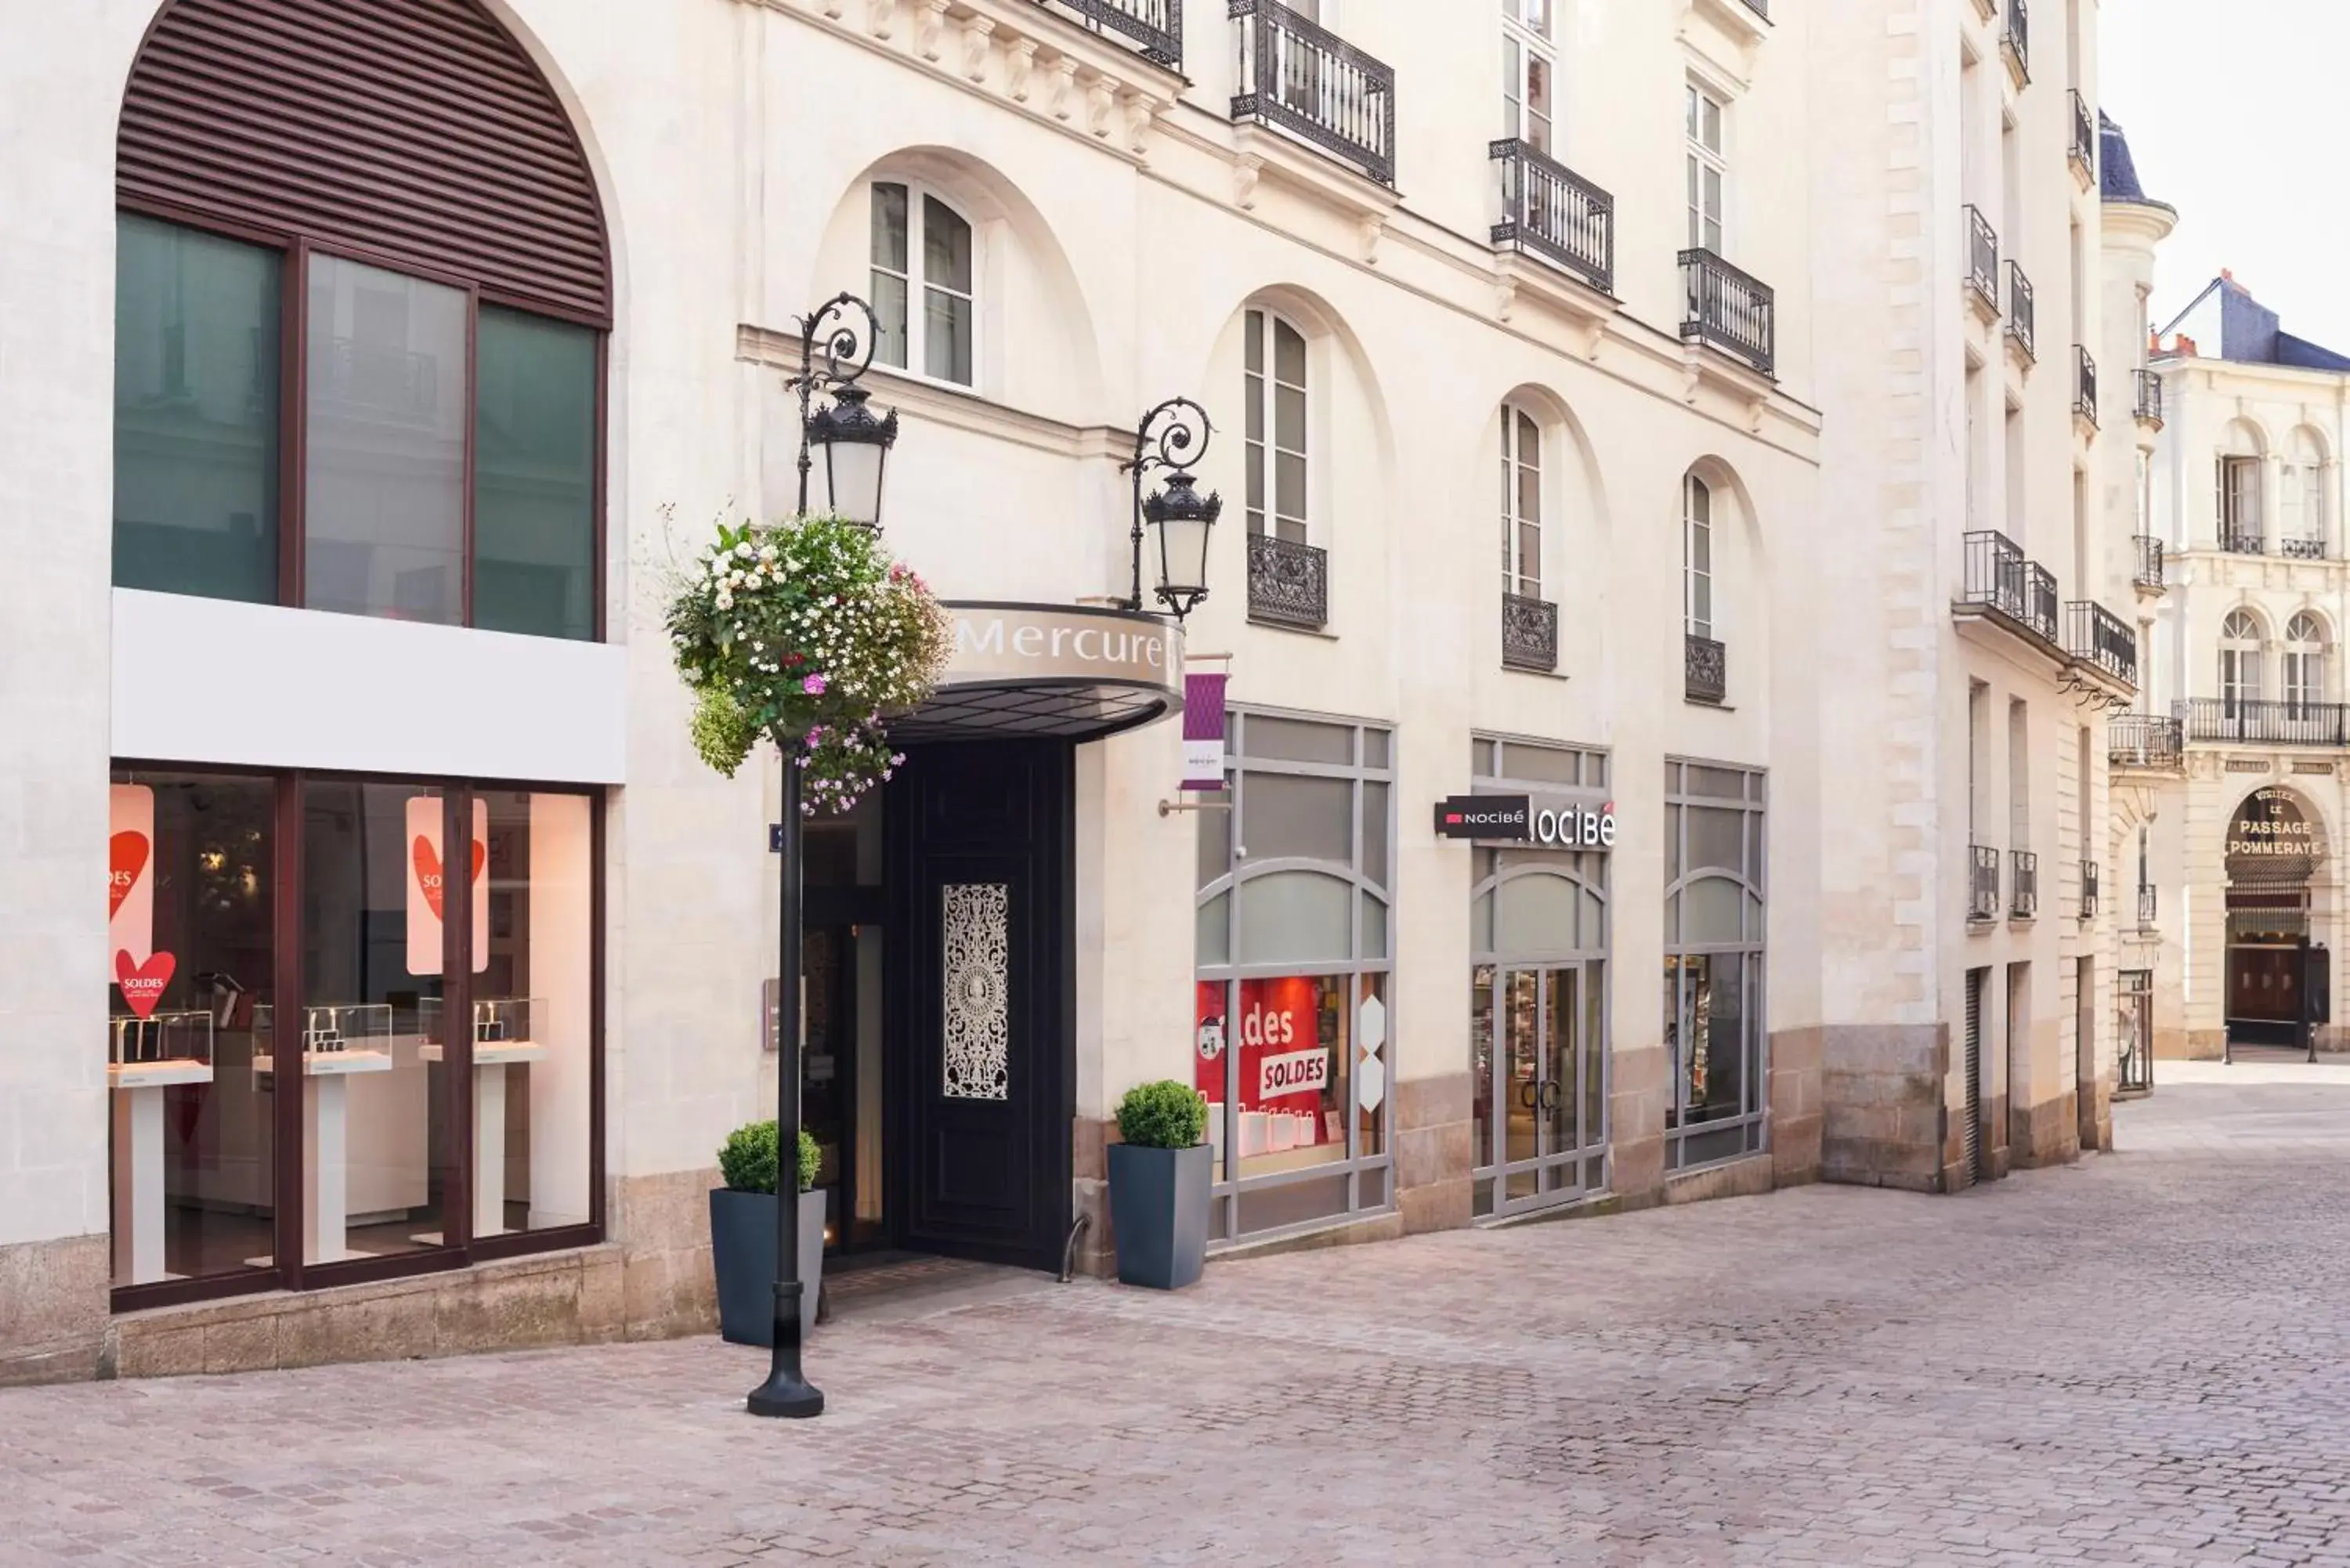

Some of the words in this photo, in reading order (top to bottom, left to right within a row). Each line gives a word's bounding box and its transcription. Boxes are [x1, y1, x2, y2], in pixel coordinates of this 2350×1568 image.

[954, 617, 1162, 667] Mercure
[2269, 805, 2282, 814] LE
[2240, 820, 2312, 834] PASSAGE
[2230, 840, 2322, 854] POMMERAYE
[125, 977, 164, 988] SOLDES
[1264, 1057, 1325, 1089] SOLDES
